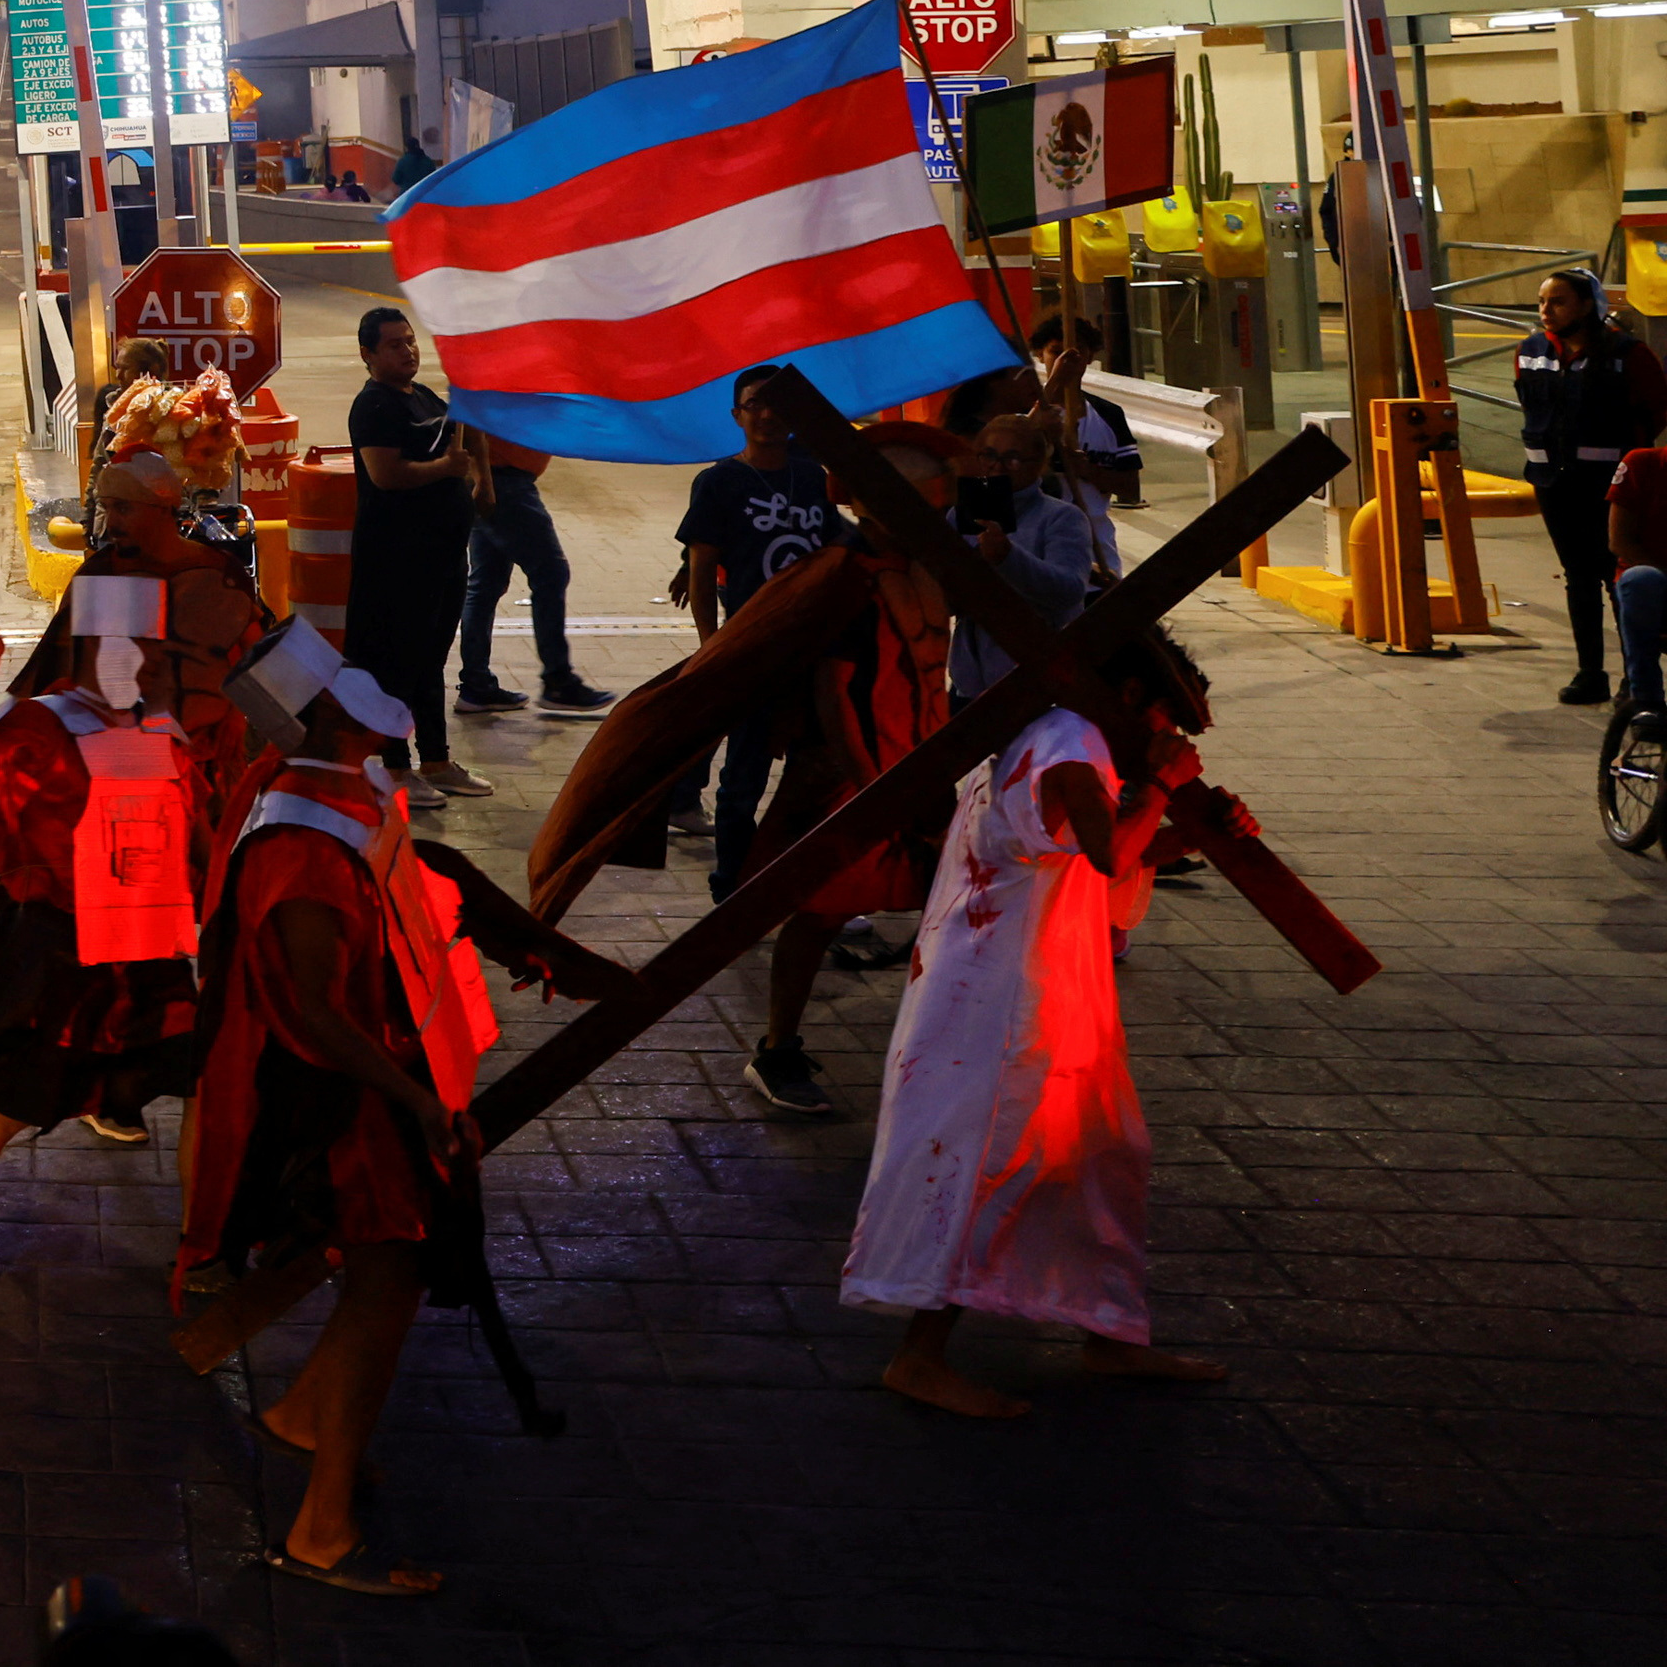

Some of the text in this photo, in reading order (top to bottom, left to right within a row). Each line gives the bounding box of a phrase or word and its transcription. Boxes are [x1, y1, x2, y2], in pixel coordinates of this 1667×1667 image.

[20, 18, 49, 28] AUTOS
[909, 17, 998, 44] STOP
[22, 35, 63, 45] AUTOBUS
[46, 45, 53, 54] 4
[22, 58, 70, 70] CAMION DE
[23, 66, 70, 78] 2 A 9 EJES
[24, 79, 74, 90] EJE EXCED
[24, 91, 56, 101] LIGERO
[25, 101, 77, 113] EJE EXCEDE
[26, 113, 70, 124] DE CARGA
[47, 126, 72, 137] SCT
[138, 291, 252, 325] ALTO
[167, 337, 255, 371] TOP
